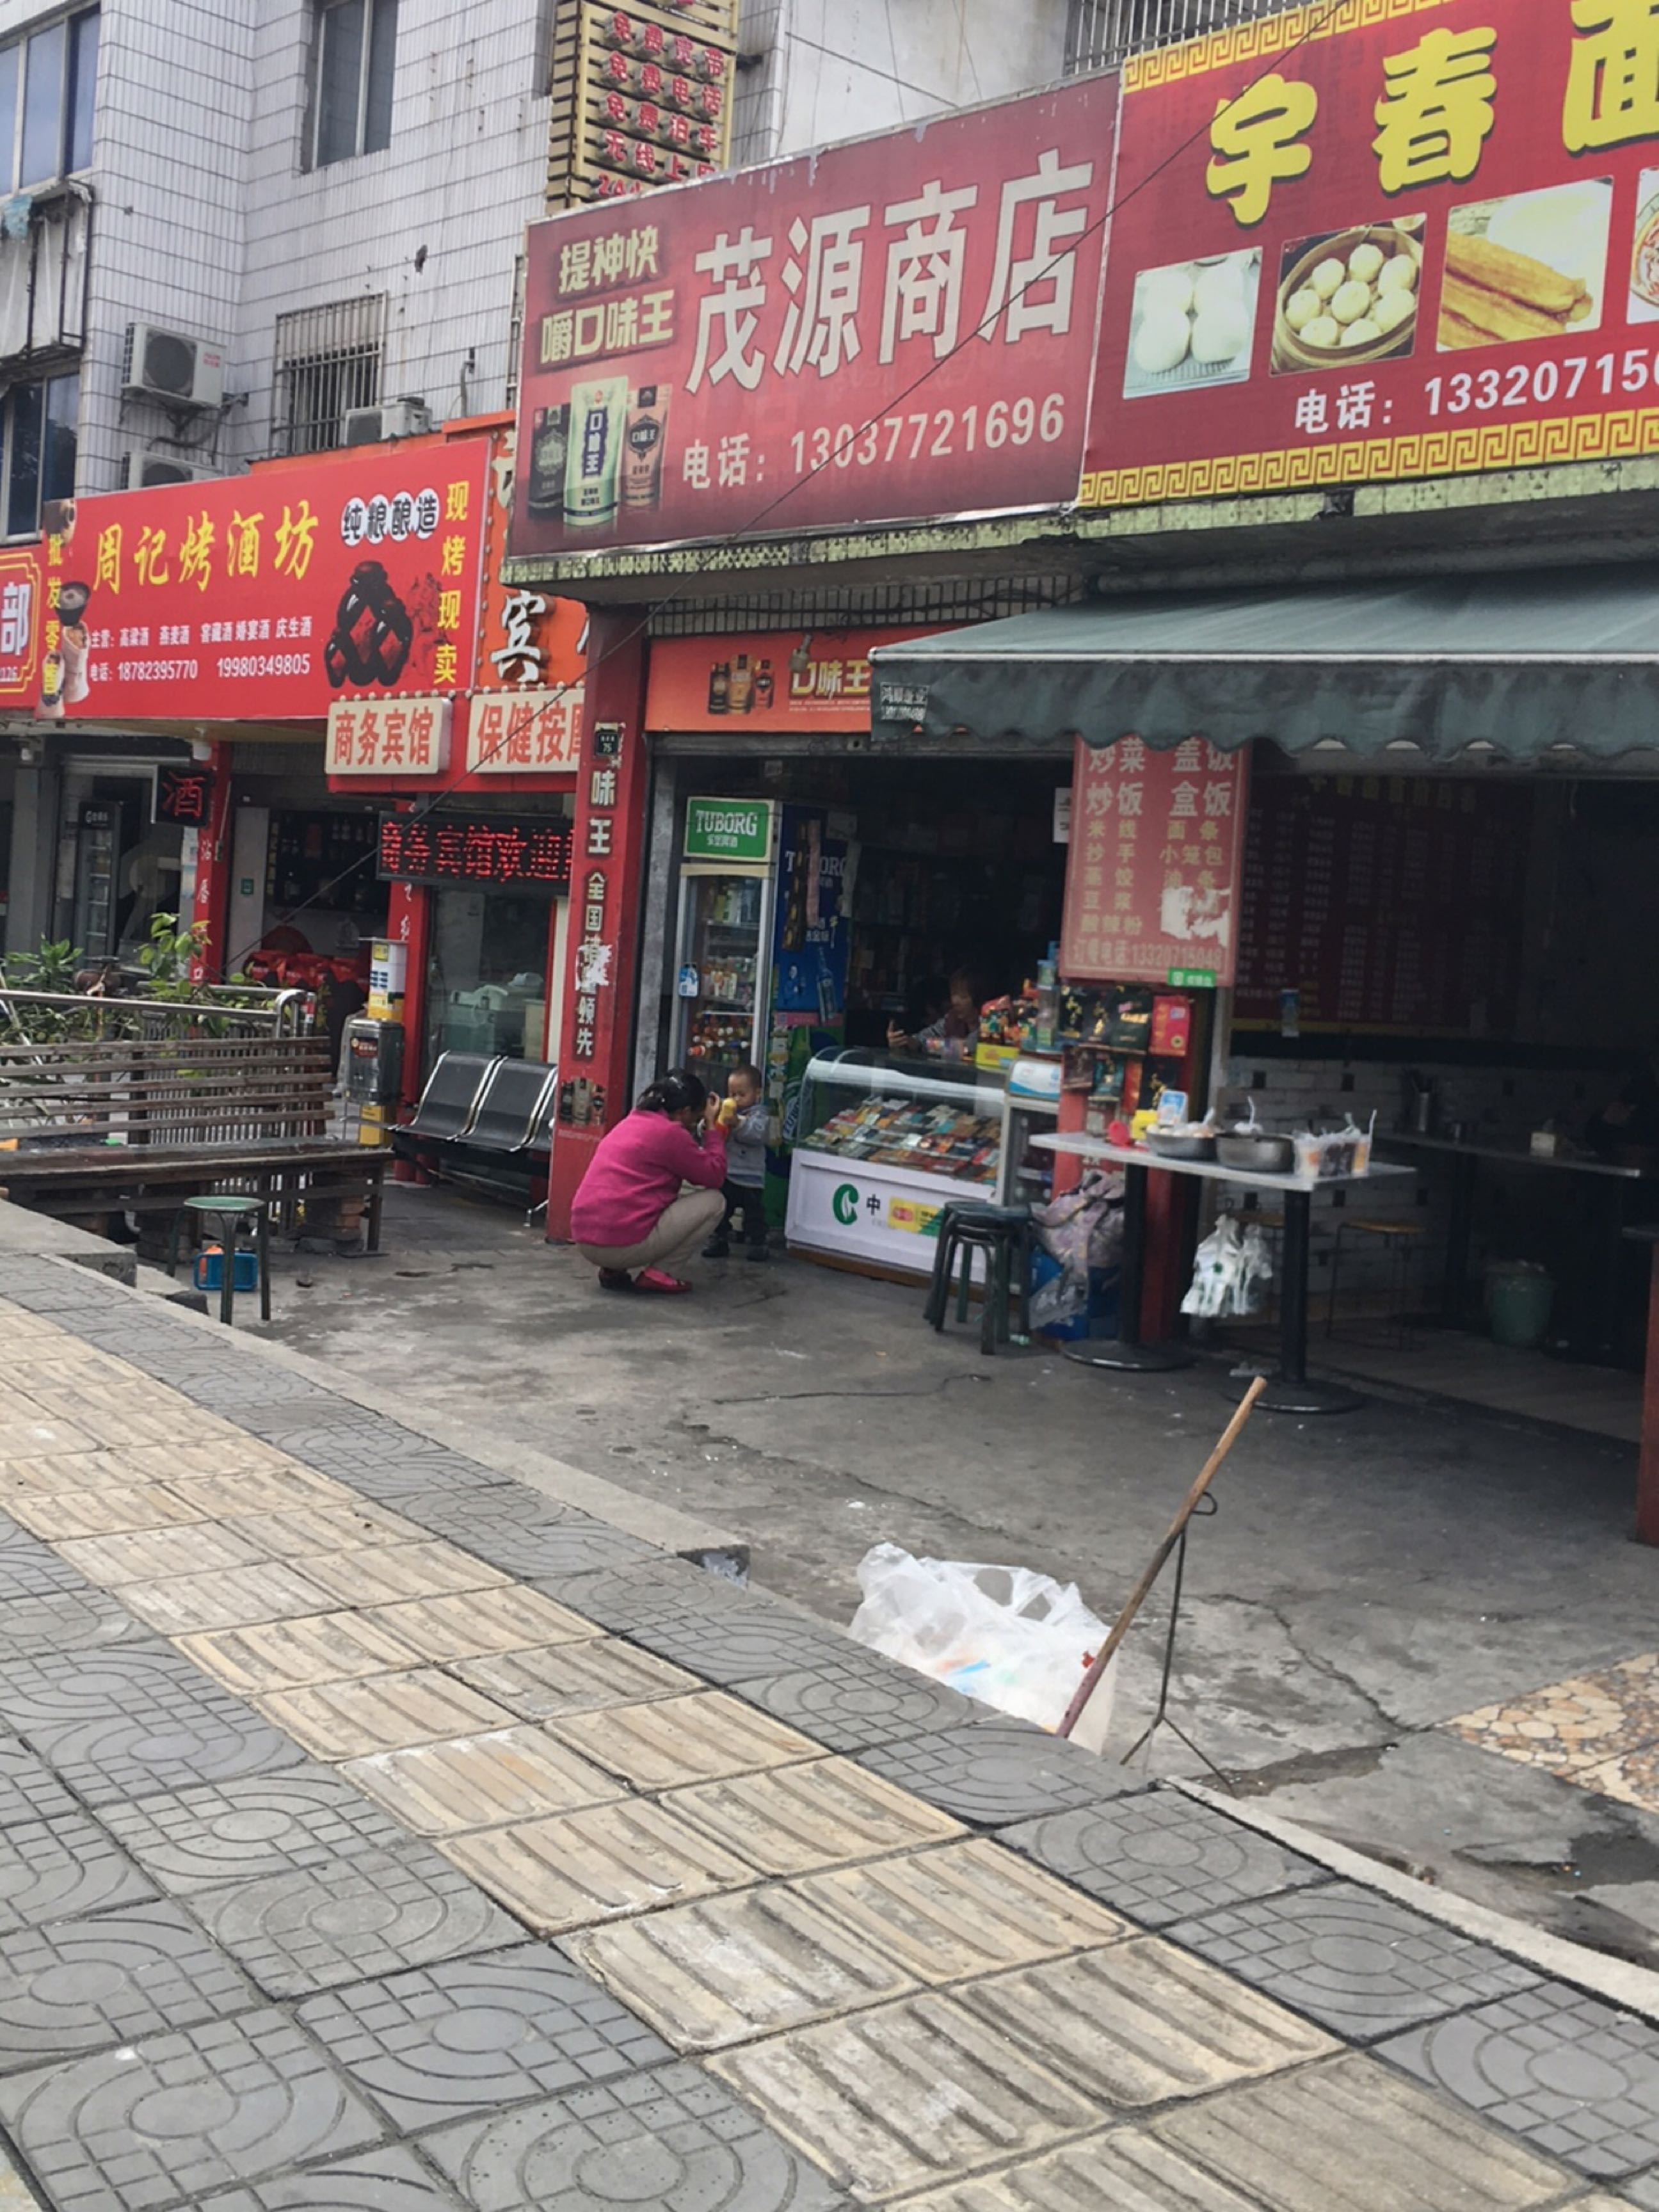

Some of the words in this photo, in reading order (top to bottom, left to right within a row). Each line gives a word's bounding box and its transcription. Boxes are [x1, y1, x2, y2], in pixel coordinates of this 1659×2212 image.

[608, 51, 722, 116] 免费电话
[1206, 0, 1659, 225] 宇春面
[605, 90, 719, 152] 免费泊车
[558, 225, 658, 294] 提神快
[683, 147, 1094, 396] 茂源商店
[541, 289, 675, 364] 嚼口味王
[1294, 381, 1393, 435] 电话：
[1424, 348, 1659, 416] 13320715
[682, 431, 765, 490] 电话：
[790, 392, 1066, 476] 13037721696
[93, 501, 319, 594] 周记烤酒坊
[342, 495, 438, 542] 纯粮酿造
[433, 481, 469, 685] 现烤现卖
[117, 659, 198, 681] 18782395770
[216, 654, 311, 677] 19980349805
[333, 708, 435, 767] 商务宾馆
[1089, 737, 1146, 773] 炒菜
[162, 771, 207, 818] 酒
[696, 810, 758, 837] TUBORG
[1086, 781, 1144, 817] 炒饭
[1169, 780, 1231, 817] 盒饭
